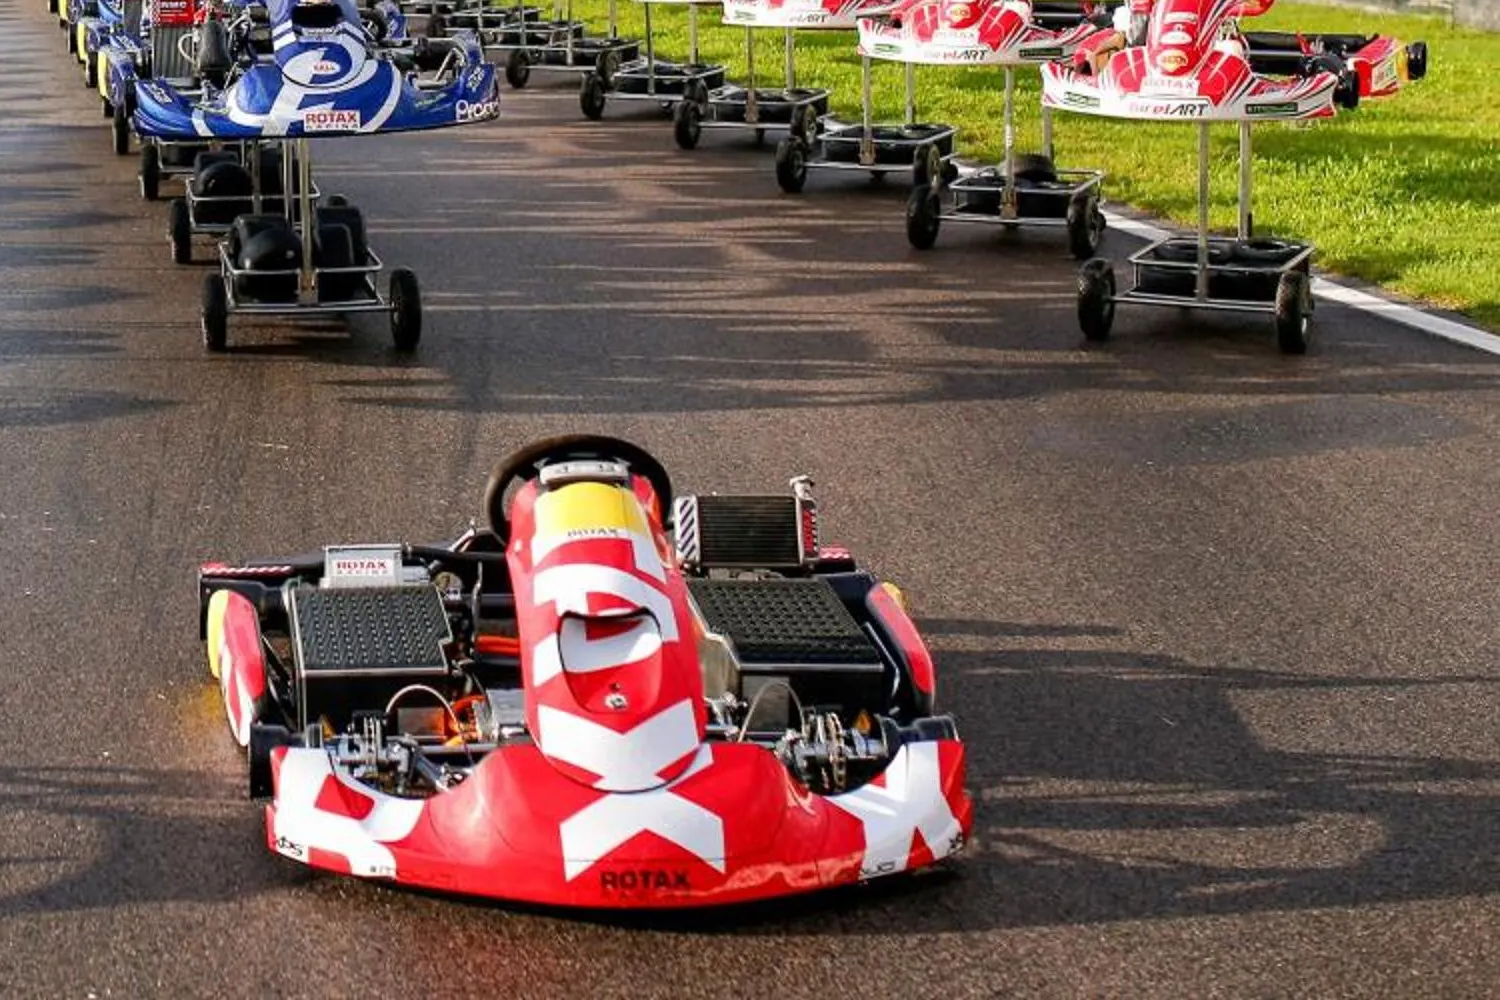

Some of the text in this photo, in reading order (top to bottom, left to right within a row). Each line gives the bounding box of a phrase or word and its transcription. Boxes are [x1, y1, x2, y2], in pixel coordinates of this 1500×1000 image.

[304, 112, 358, 124] ROTAX
[336, 559, 389, 570] ROTAX
[601, 869, 690, 889] ROTAX
